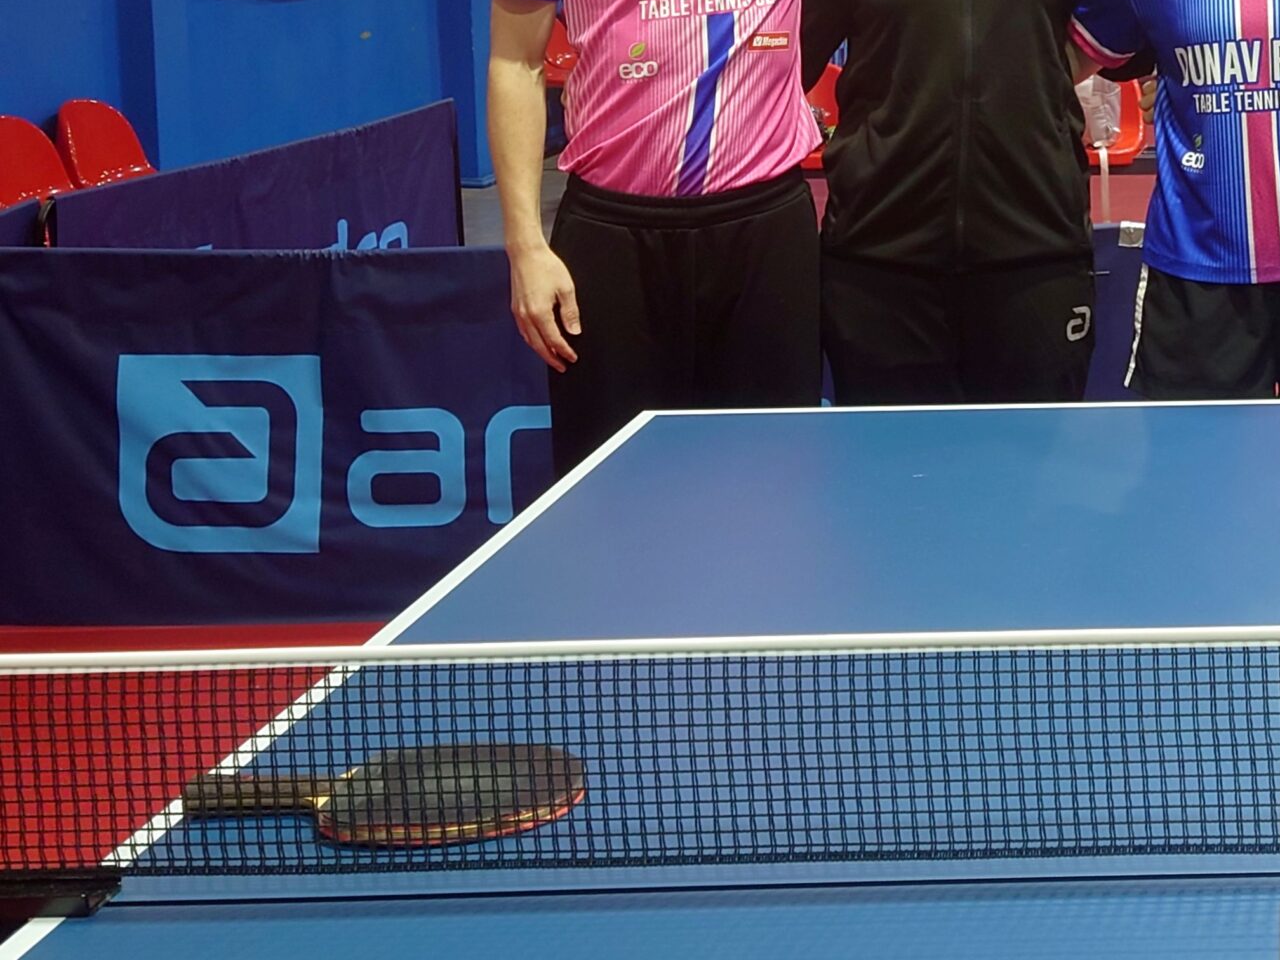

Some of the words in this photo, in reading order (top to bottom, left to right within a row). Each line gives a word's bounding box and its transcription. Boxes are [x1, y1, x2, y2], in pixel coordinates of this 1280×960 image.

[618, 60, 659, 79] eco
[1174, 41, 1261, 87] DUNAV
[1193, 91, 1231, 113] TABLE
